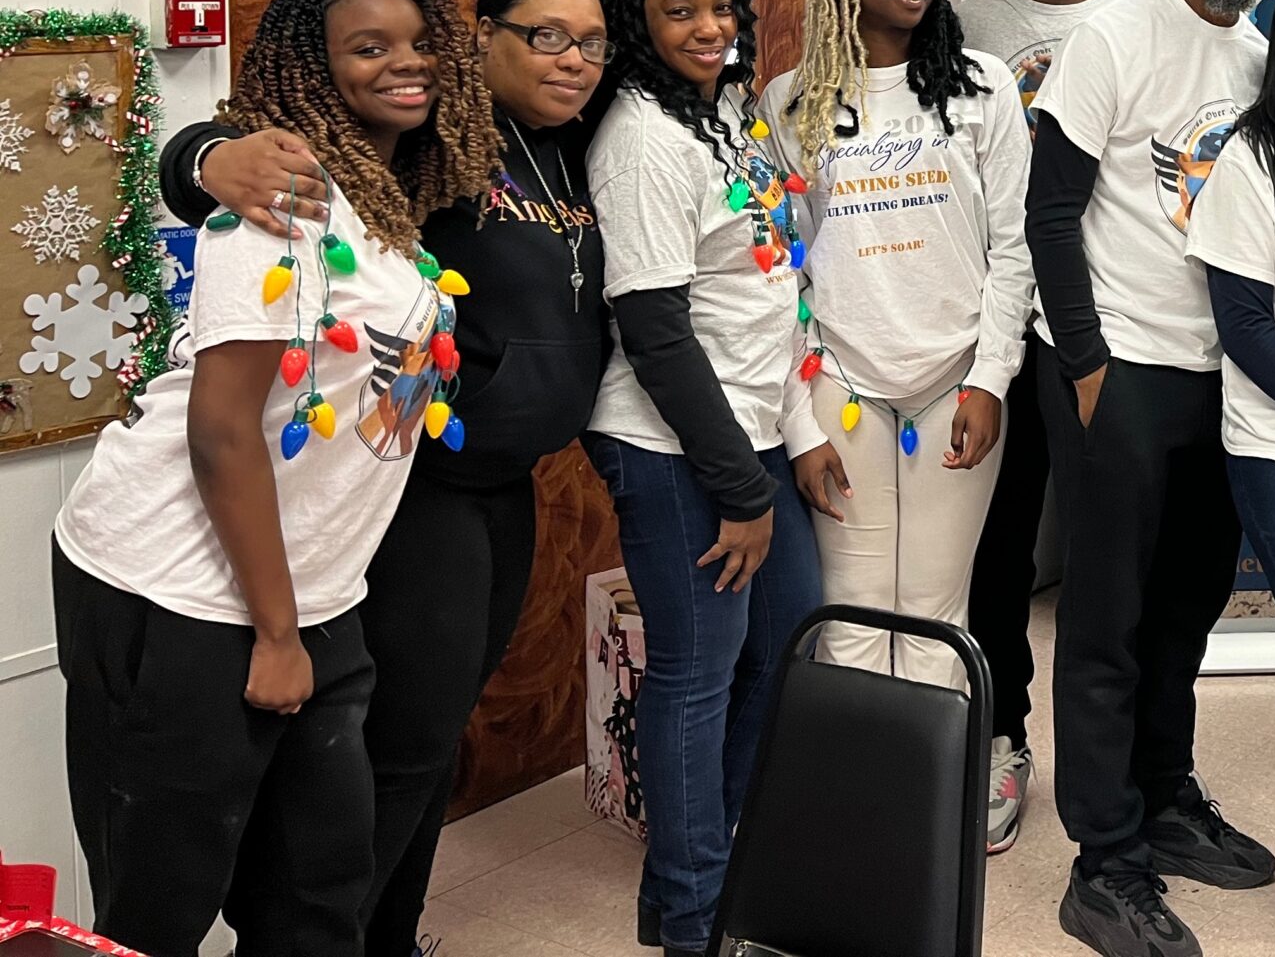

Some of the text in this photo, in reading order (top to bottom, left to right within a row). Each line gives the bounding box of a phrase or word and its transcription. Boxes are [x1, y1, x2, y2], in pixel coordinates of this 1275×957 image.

[1205, 109, 1225, 121] Over
[817, 131, 950, 178] Specializing in
[833, 174, 900, 196] ANTING
[858, 239, 925, 258] LET'S SOAR!
